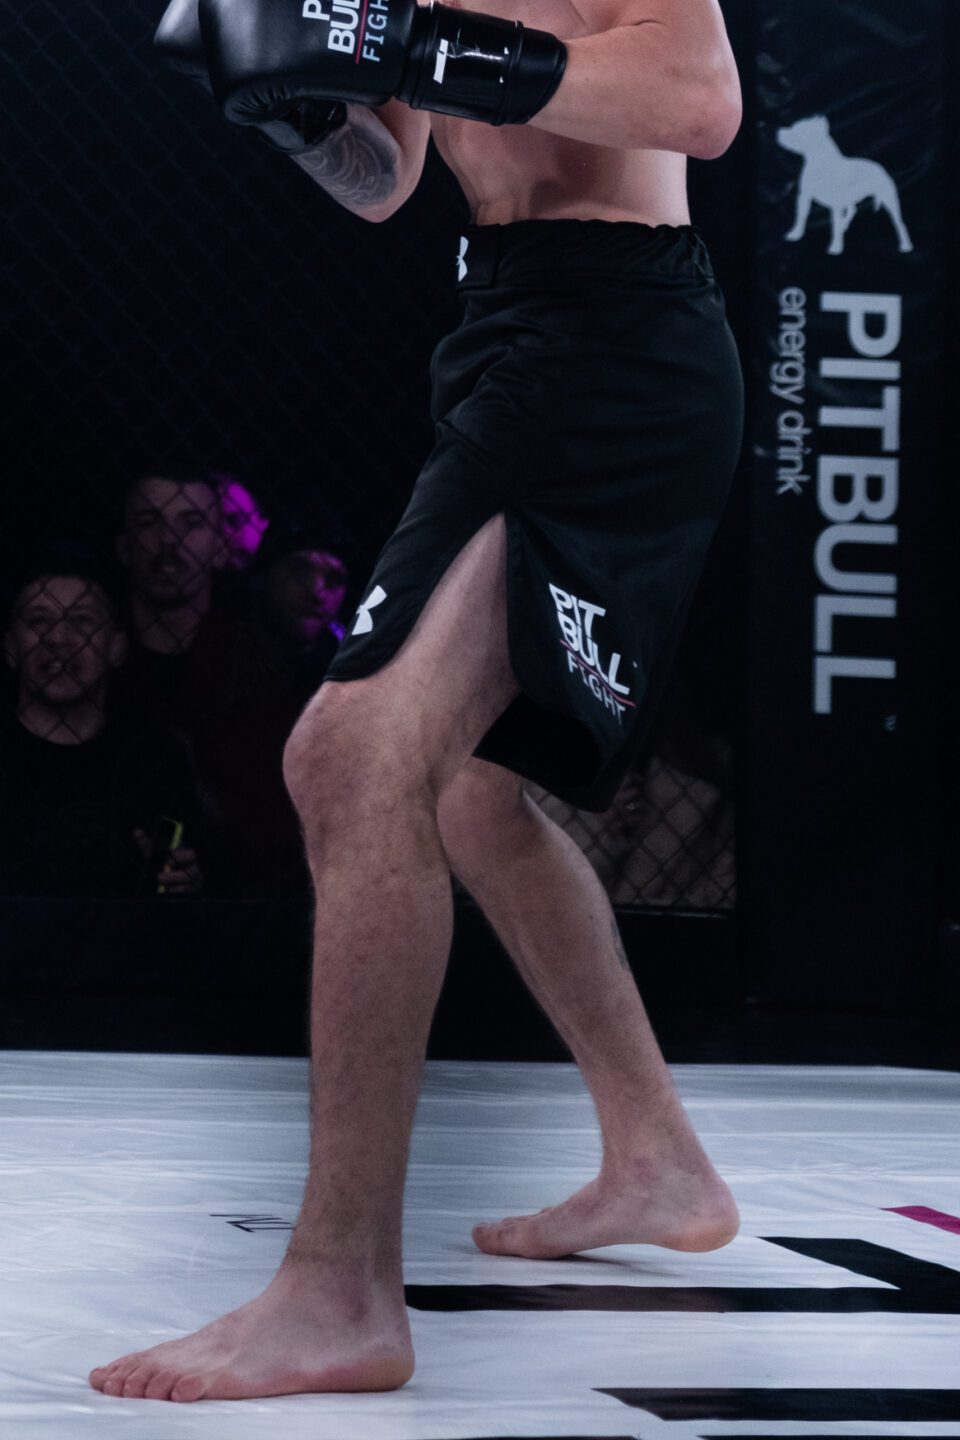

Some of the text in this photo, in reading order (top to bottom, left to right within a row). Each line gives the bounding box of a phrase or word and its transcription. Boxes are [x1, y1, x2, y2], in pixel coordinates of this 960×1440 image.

[769, 286, 813, 496] energy drink
[814, 292, 902, 714] PITBULL
[548, 582, 607, 637] PIT
[557, 611, 630, 696] BULL
[567, 649, 626, 726] FIGHT
